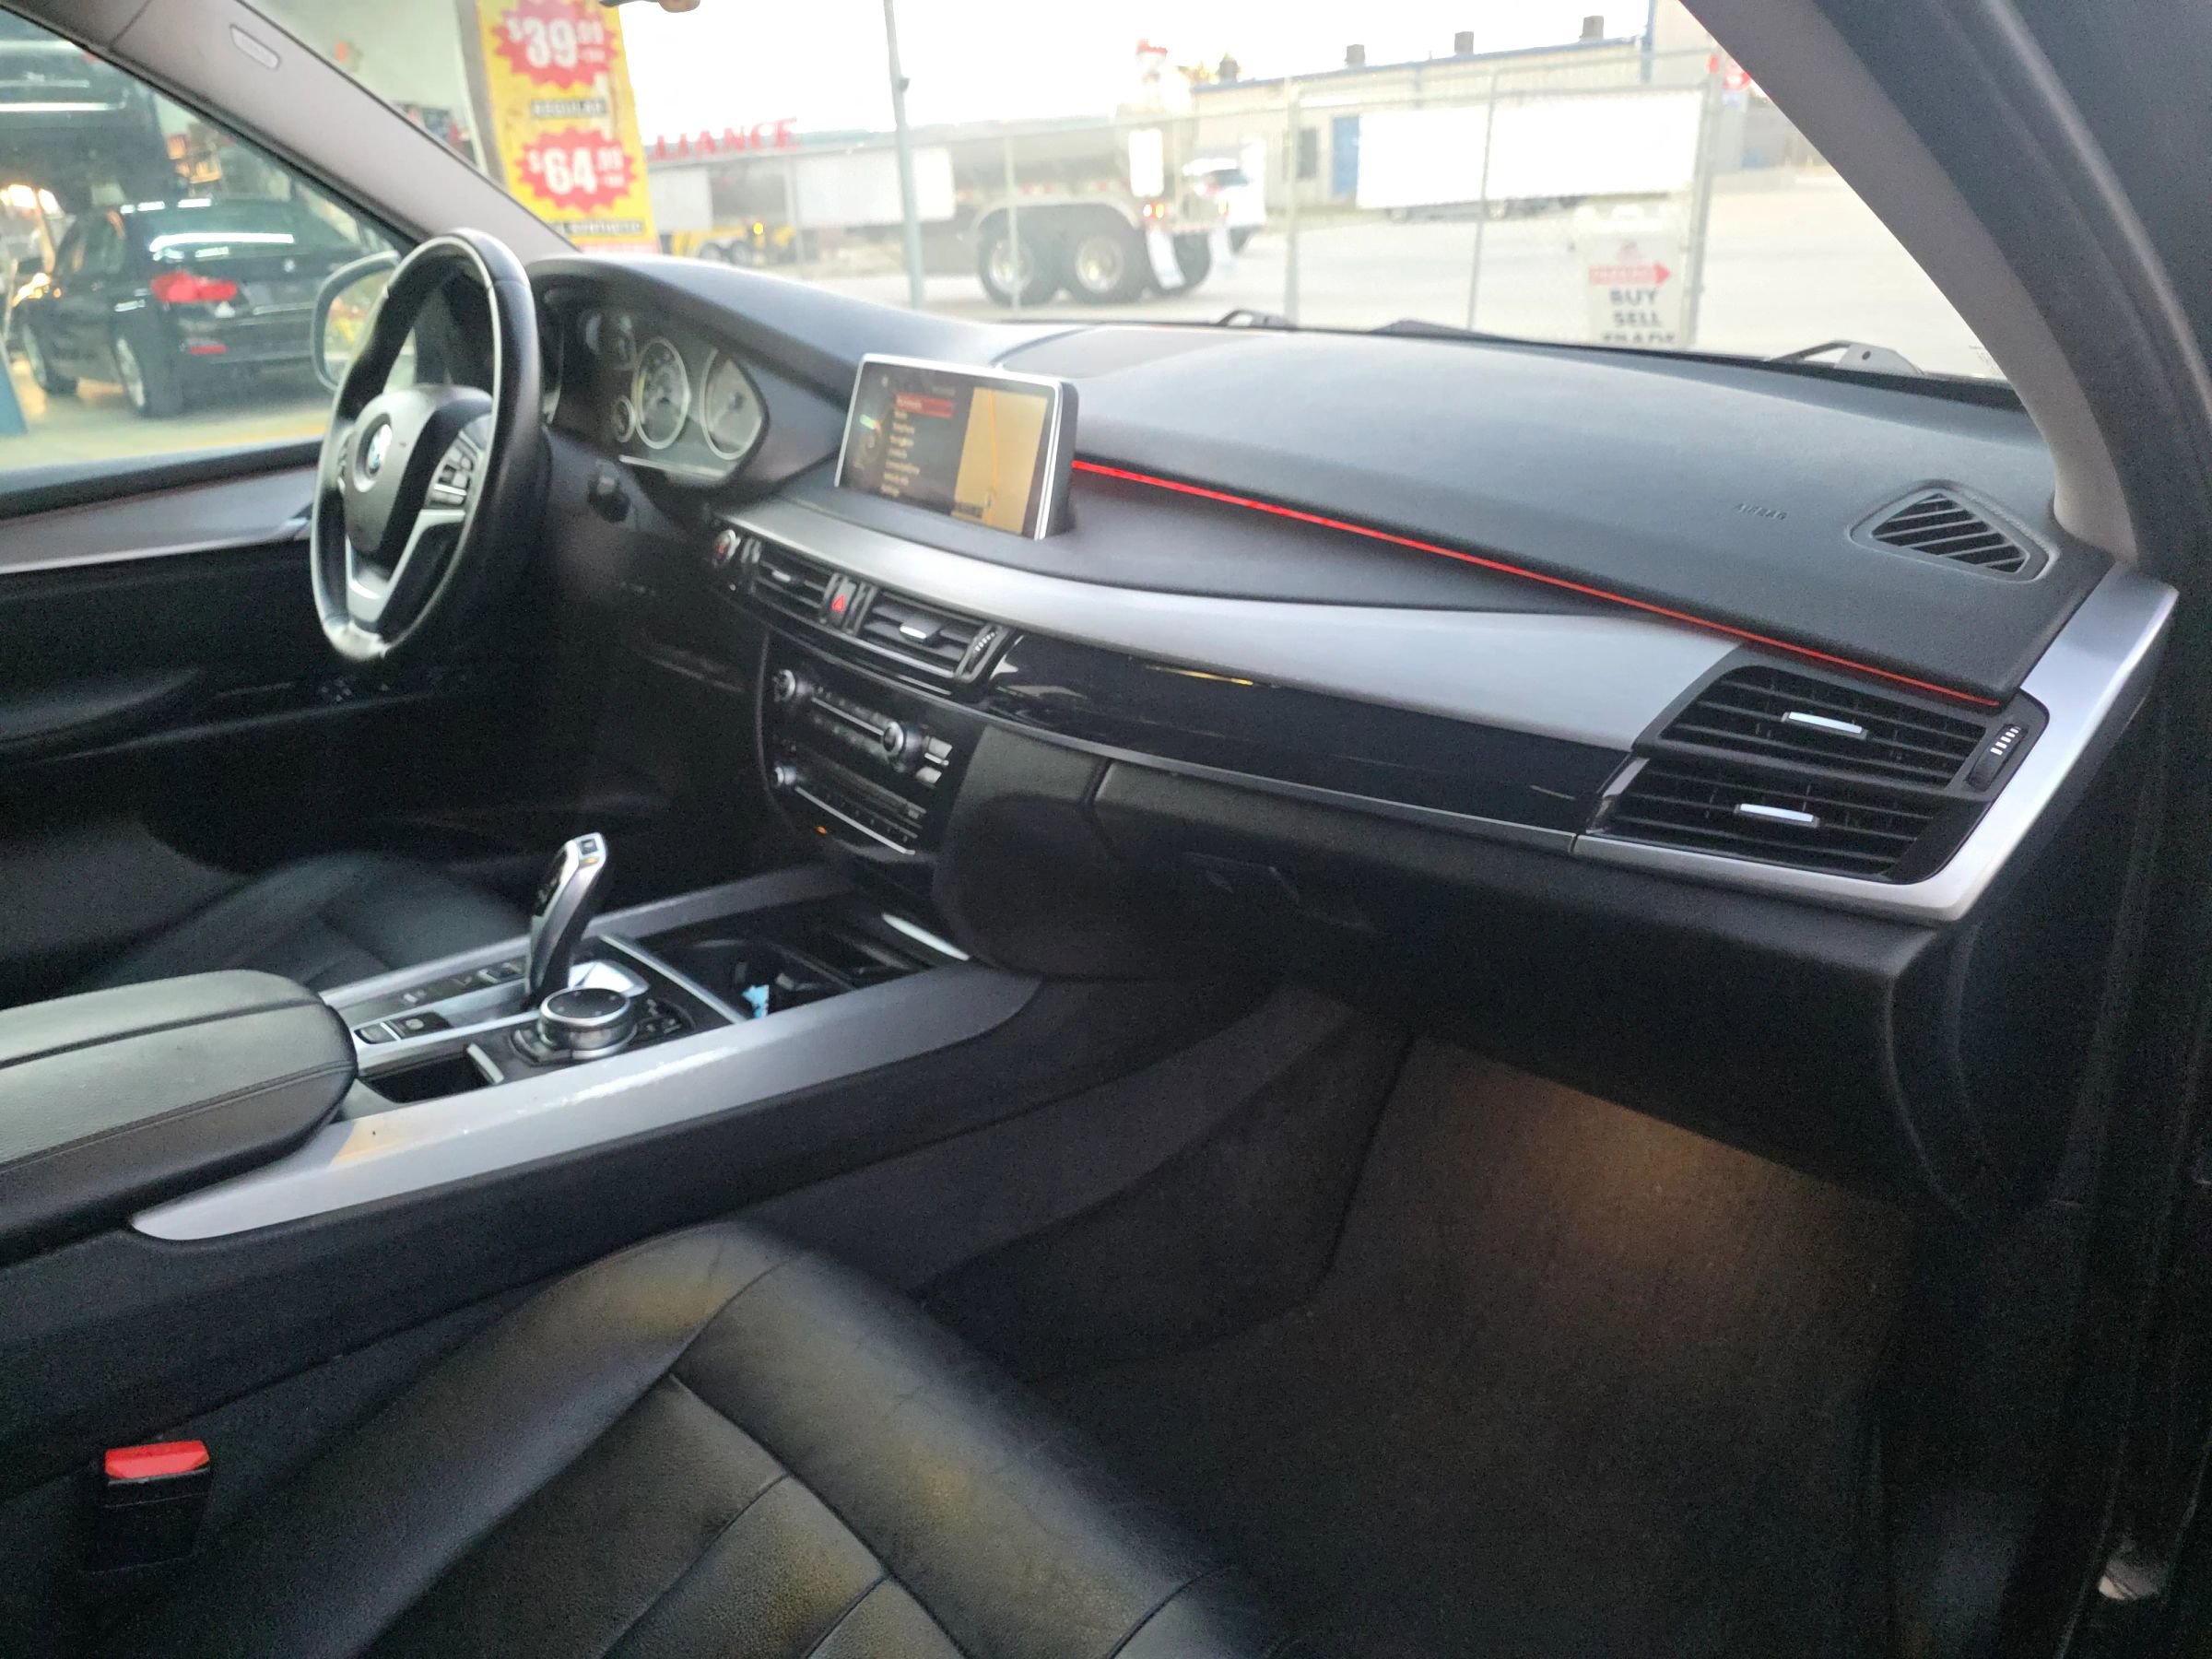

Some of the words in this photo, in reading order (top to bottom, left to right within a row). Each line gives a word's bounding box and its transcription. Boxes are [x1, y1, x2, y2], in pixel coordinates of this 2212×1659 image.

[648, 117, 800, 162] LIANCE
[1609, 288, 1657, 306] BUY
[1613, 311, 1662, 326] SELL
